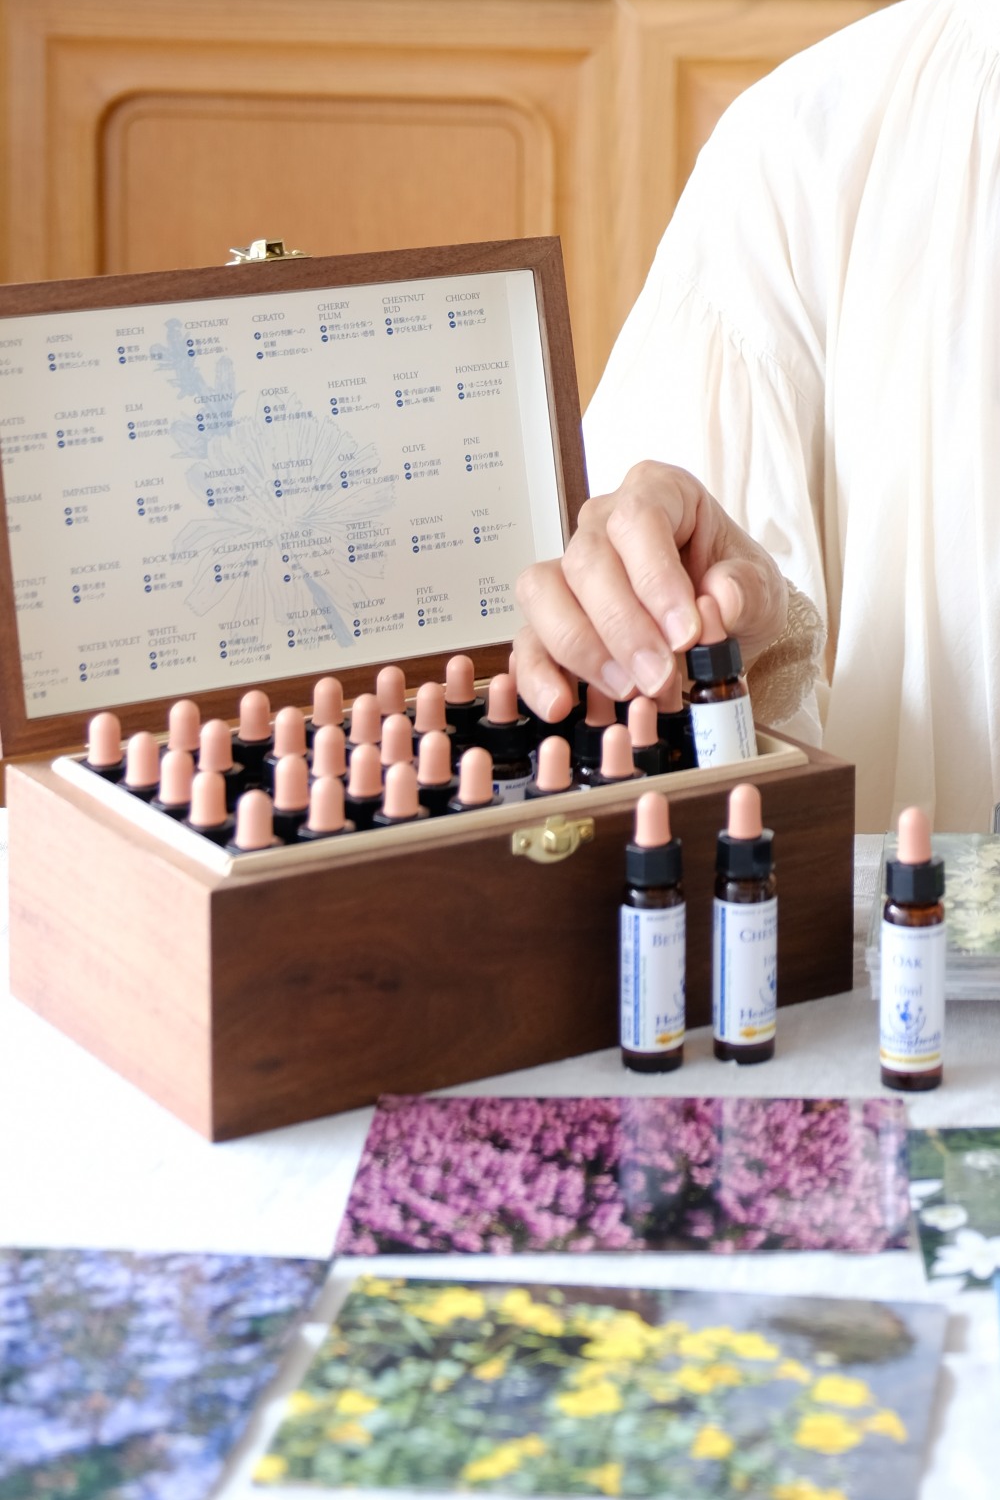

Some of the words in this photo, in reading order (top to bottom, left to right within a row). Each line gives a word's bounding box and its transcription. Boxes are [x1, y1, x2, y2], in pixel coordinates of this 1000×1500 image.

[381, 293, 425, 306] CHESTNUT
[445, 292, 481, 303] CHICORY
[317, 301, 350, 312] CHERRY
[383, 306, 401, 315] BUD
[251, 312, 285, 323] CERATO
[318, 312, 342, 321] PLUM
[184, 318, 229, 330] CENTAURY
[115, 327, 145, 337] BEECH
[46, 334, 73, 344] ASPEN
[455, 360, 510, 374] HONEYSUCKLE
[393, 371, 420, 381] HOLLY
[327, 377, 367, 389] HEATHER
[261, 386, 289, 397] GORSE
[193, 393, 233, 404] GENTIAN
[54, 410, 79, 420] CRAB
[80, 407, 106, 418] APPLE
[125, 403, 143, 412] ELM
[463, 436, 481, 446] PINE
[402, 443, 427, 454] OLIVE
[338, 452, 357, 462] OAK
[271, 458, 313, 470] MUSTARD
[204, 466, 245, 479] MIMULUS
[135, 477, 165, 488] LARCH
[62, 484, 111, 498] IMPATIENS
[471, 508, 490, 518] VINE
[346, 520, 372, 531] SWEET
[410, 515, 443, 526] VERVAIN
[280, 531, 302, 541] STAR
[302, 528, 314, 538] OF
[346, 527, 391, 541] CHESTNUT
[212, 539, 273, 555] SCLERANTHUS
[281, 536, 332, 550] BETHLEHEM
[142, 555, 167, 565] ROCK
[168, 550, 199, 562] WATER
[70, 565, 96, 575] ROCK
[98, 561, 121, 571] ROSE
[478, 577, 496, 586] FIVE
[416, 586, 434, 596] FIVE
[479, 584, 511, 596] FLOWER
[352, 598, 386, 610] WILLOW
[417, 593, 450, 605] FLOWER
[286, 610, 309, 620] WILD
[310, 607, 332, 617] ROSE
[218, 620, 241, 631] WILD
[242, 617, 260, 627] OAT
[147, 626, 178, 637] WHITE
[78, 641, 107, 653] WATER
[108, 636, 142, 648] VIOLET
[148, 633, 198, 647] CHESTNUT
[892, 954, 923, 969] OAK
